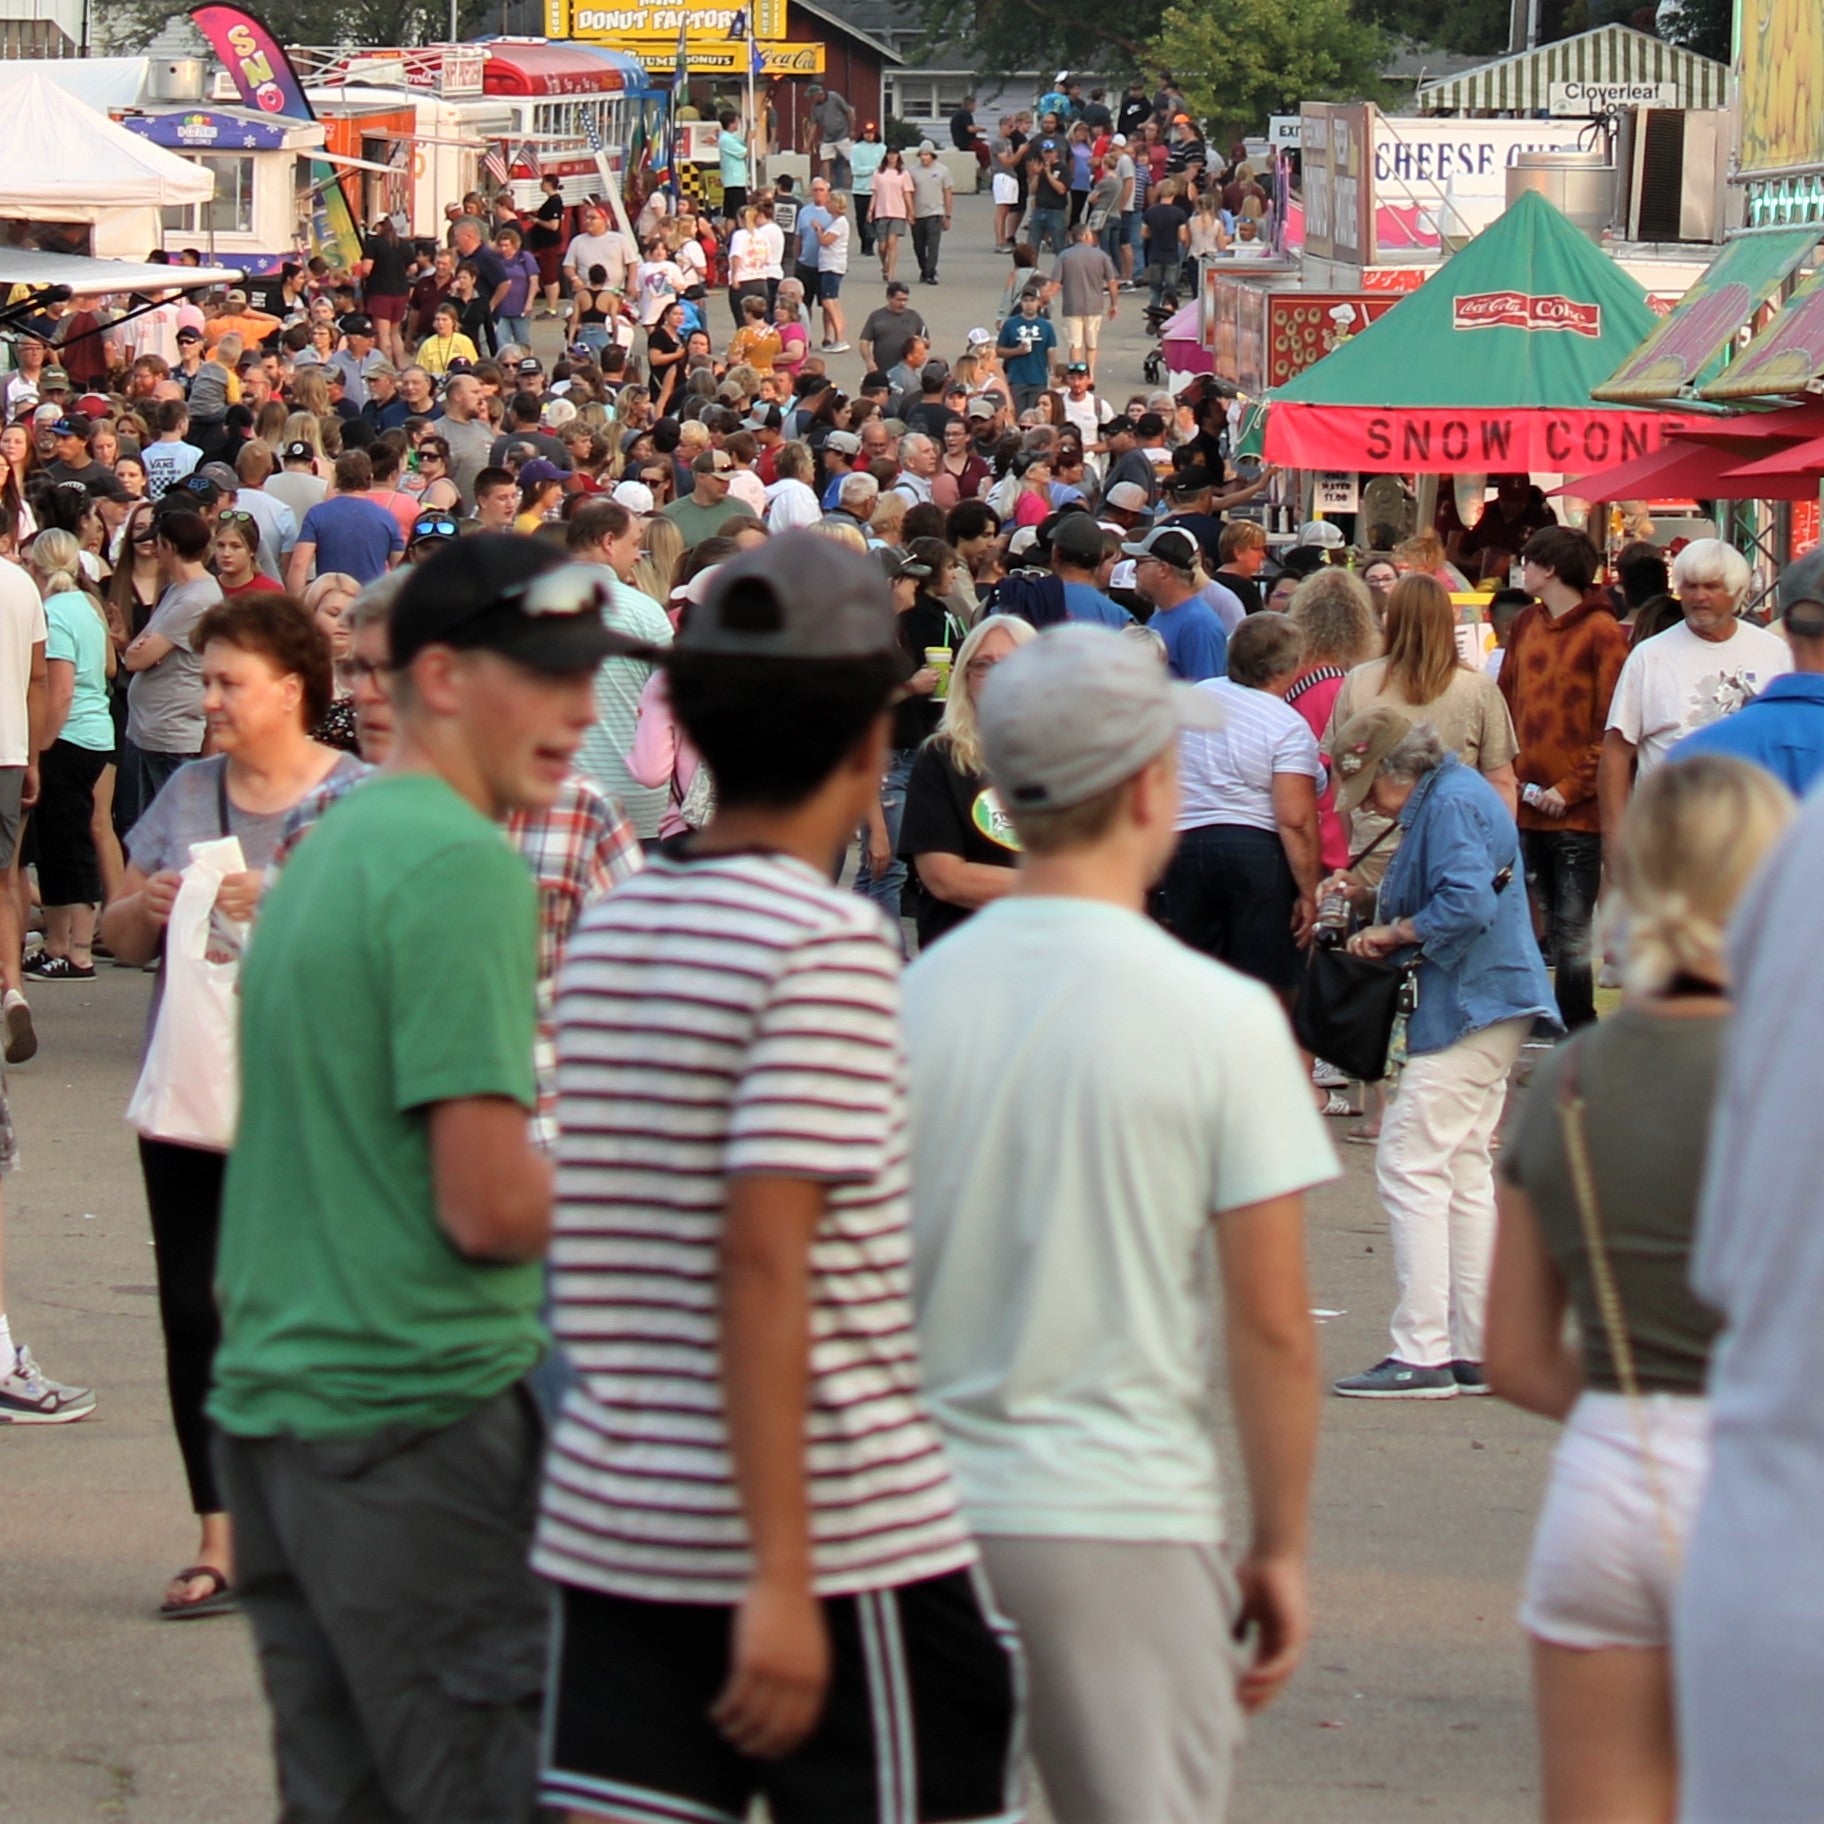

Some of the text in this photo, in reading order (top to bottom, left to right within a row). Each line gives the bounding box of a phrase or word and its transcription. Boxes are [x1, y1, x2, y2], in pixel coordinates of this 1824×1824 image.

[578, 10, 648, 31] DONUT
[1564, 83, 1661, 100] Cloverleaf
[1375, 142, 1496, 182] CHEESE
[1535, 299, 1586, 323] Coke
[1366, 419, 1512, 462] SNOW
[150, 457, 176, 468] VANS
[1321, 482, 1351, 491] WATER
